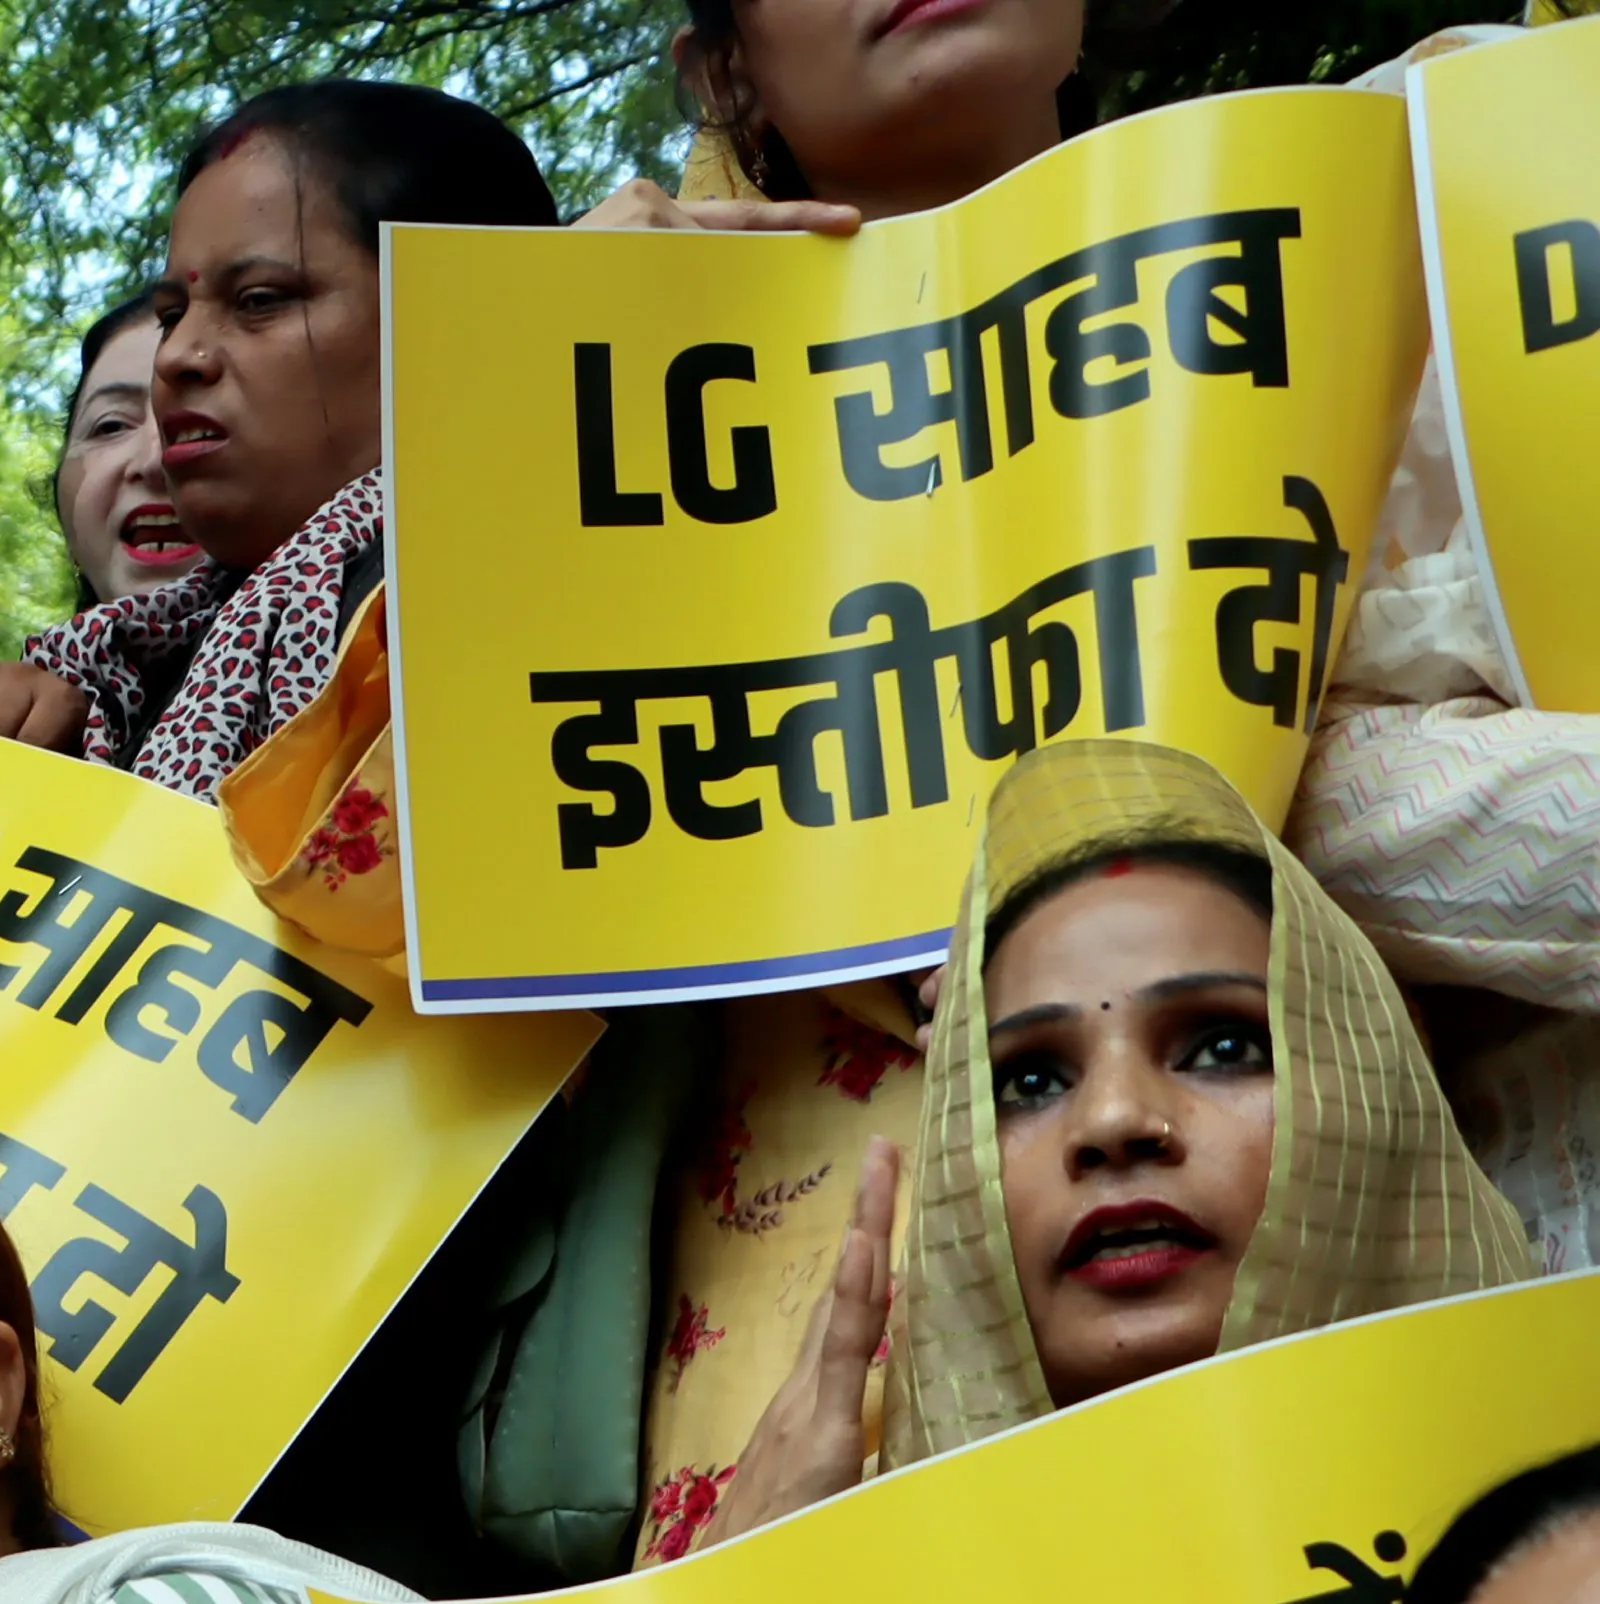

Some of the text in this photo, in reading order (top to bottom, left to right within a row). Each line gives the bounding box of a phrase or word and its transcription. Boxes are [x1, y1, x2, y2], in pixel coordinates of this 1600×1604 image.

[574, 207, 1301, 527] LG साहब
[530, 475, 1348, 870] इस्तीफा दो
[28, 1183, 241, 1403] दो
